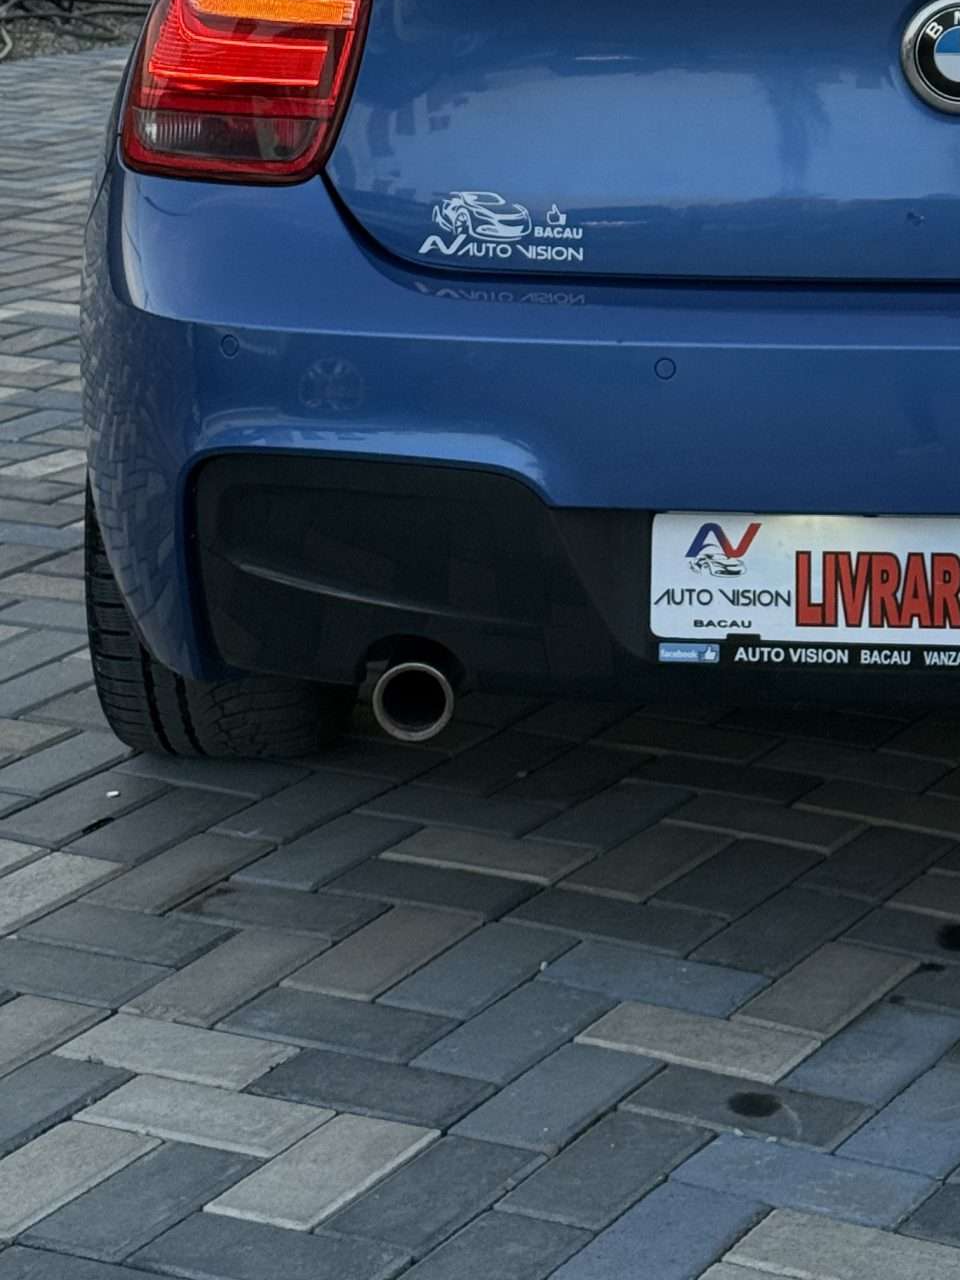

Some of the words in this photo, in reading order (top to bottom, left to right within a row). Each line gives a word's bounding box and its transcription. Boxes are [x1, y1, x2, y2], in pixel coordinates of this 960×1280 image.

[534, 226, 583, 240] BACAU
[457, 242, 512, 258] AUTO
[516, 244, 584, 261] VISION
[653, 588, 714, 606] AUTO
[718, 588, 792, 607] VISION
[693, 619, 753, 629] BACAU
[734, 647, 785, 663] AUTO
[789, 648, 849, 664] VISION
[860, 649, 911, 665] BACAU
